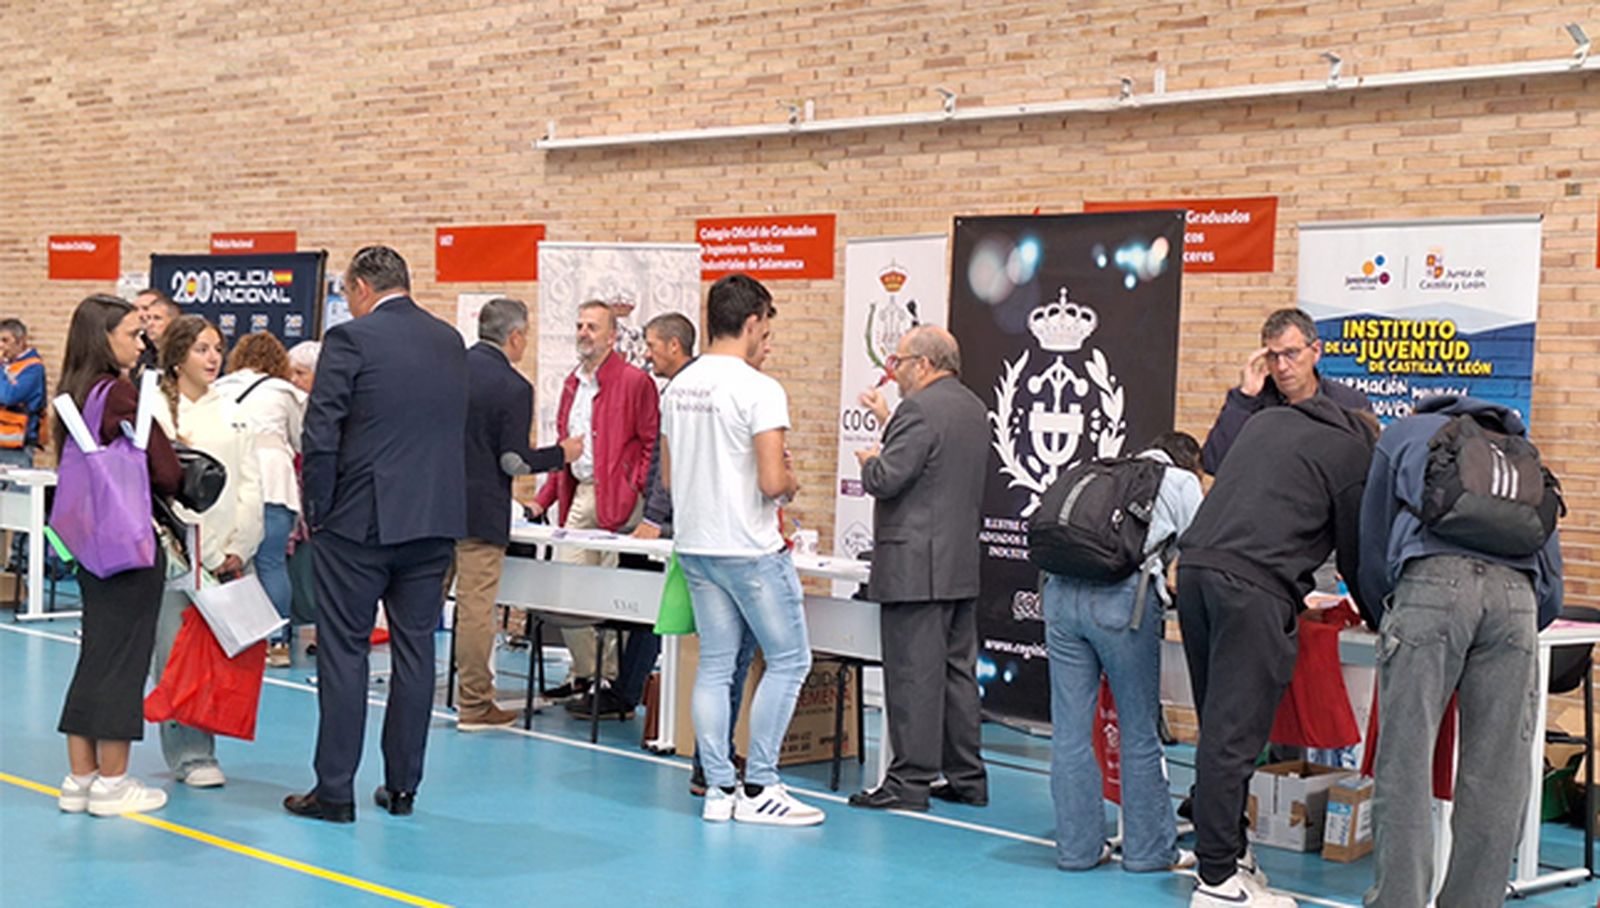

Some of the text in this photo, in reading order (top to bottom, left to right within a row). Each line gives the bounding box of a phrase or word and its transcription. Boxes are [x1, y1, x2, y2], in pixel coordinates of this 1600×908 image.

[1185, 210, 1250, 224] Graduados
[700, 224, 818, 241] Colegio Oficial de Graduados
[1184, 231, 1205, 244] cos
[1183, 250, 1215, 263] ceres
[171, 270, 213, 303] 200
[212, 287, 291, 303] NACIONAL
[1343, 319, 1456, 340] INSTITUTO
[1324, 340, 1471, 364] DE LA JUVENTUD
[1368, 358, 1492, 375] DE CASTILLA Y LEÓN
[842, 409, 880, 432] COG
